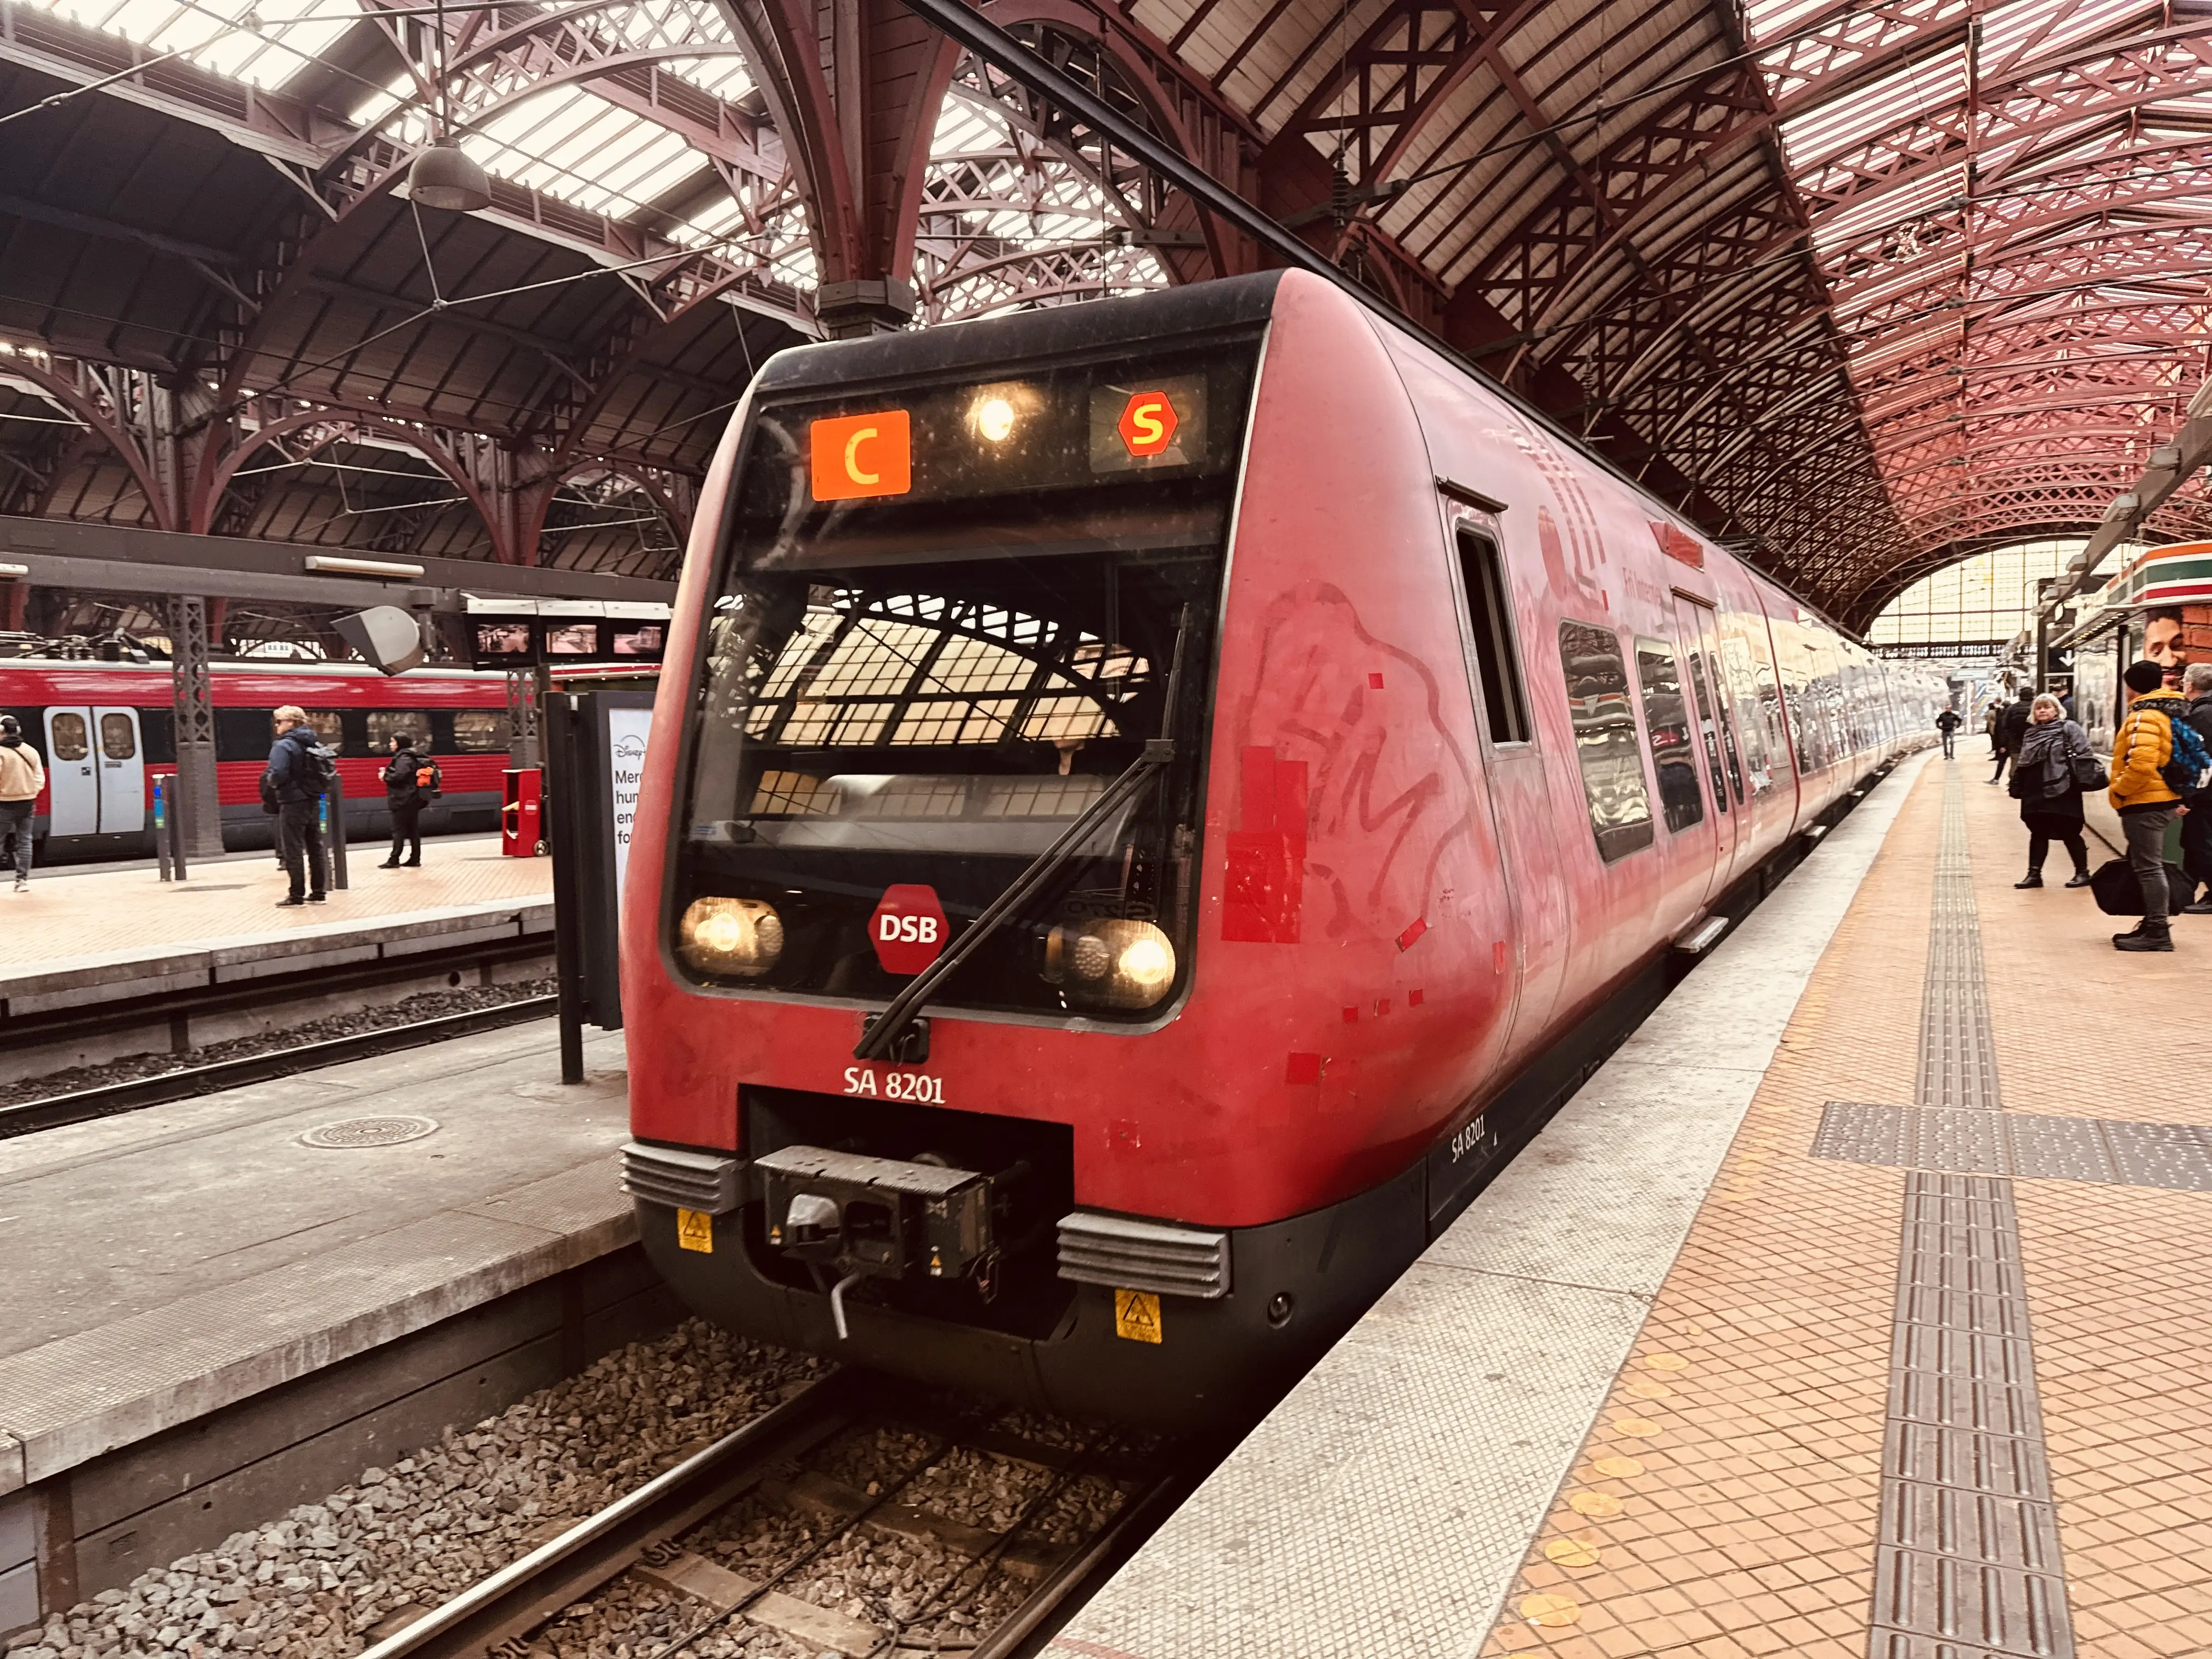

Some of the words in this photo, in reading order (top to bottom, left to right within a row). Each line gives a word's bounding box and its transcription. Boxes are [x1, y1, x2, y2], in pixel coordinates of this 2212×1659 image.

[1132, 403, 1164, 444] S
[844, 427, 879, 484] C
[615, 770, 642, 783] Mer
[618, 831, 632, 844] fo
[879, 914, 938, 943] DSB
[843, 1066, 878, 1096] SA
[885, 1072, 946, 1104] 8201
[1452, 1132, 1464, 1164] SA
[1465, 1114, 1485, 1150] 8201
